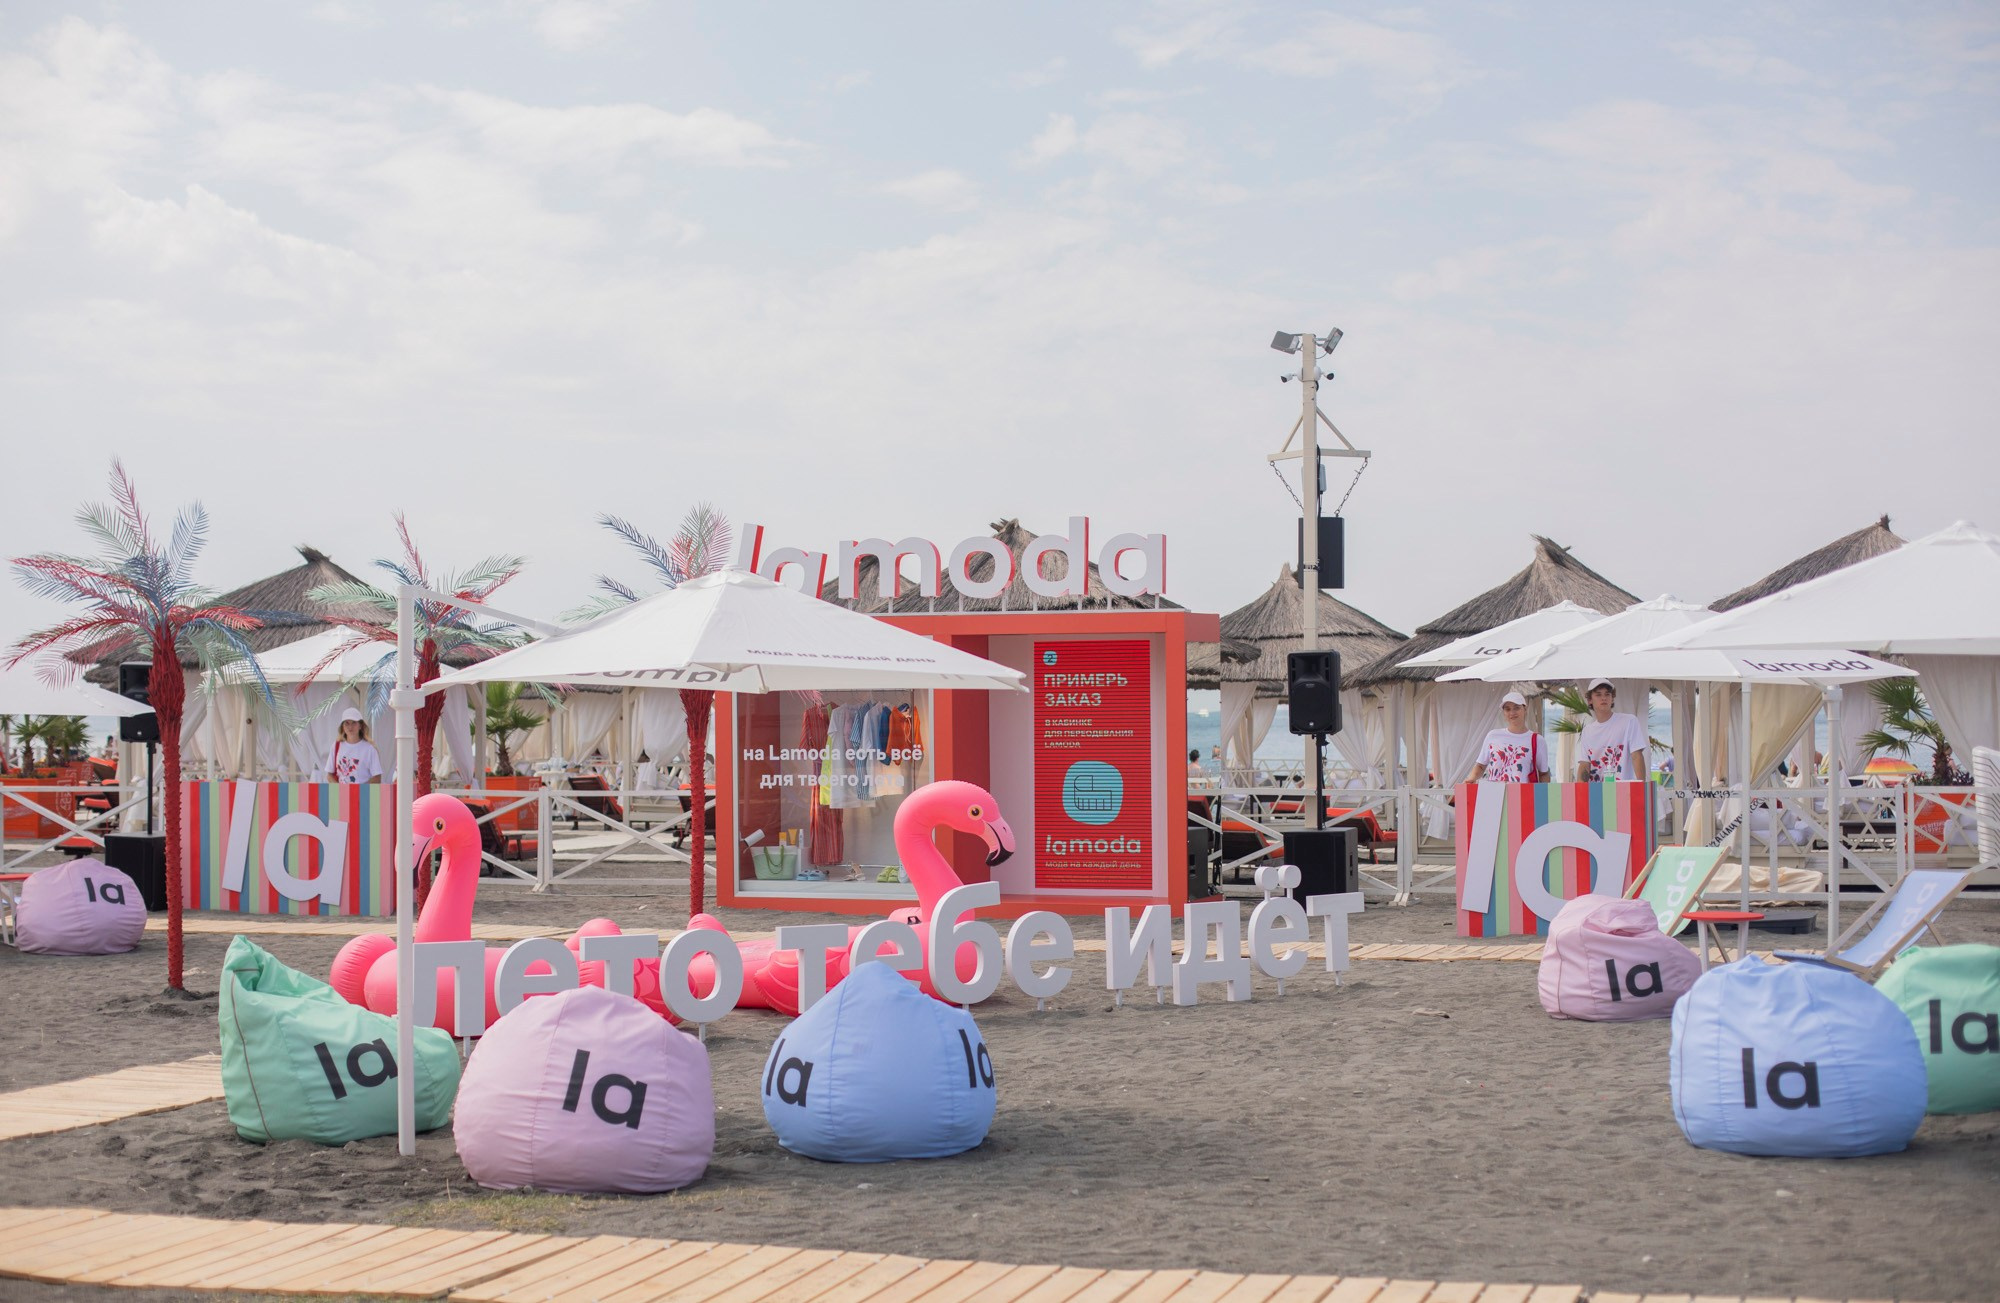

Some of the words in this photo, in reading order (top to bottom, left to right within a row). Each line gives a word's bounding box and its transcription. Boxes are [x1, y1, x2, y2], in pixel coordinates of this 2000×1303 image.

[738, 516, 1166, 599] lamoda
[1043, 673, 1128, 687] ПРИМЕРЬ
[1742, 659, 1873, 672] lamoda
[1044, 693, 1102, 707] ЗАКАЗ
[743, 748, 764, 761] на
[769, 745, 841, 761] Lamoda
[845, 748, 886, 761] есть
[891, 744, 922, 761] всё
[1044, 730, 1062, 738] ДЛЯ
[759, 774, 794, 789] для
[797, 774, 859, 787] твоего
[222, 778, 348, 905] la
[1045, 835, 1141, 855] lamoda
[1083, 860, 1118, 869] каждый
[1461, 780, 1631, 922] la
[84, 877, 126, 905] la
[776, 881, 1074, 1013] тебе
[1105, 864, 1364, 1006] идёт
[1605, 959, 1663, 1001] la
[1929, 999, 2000, 1055] la
[312, 1039, 398, 1100] la
[764, 1038, 814, 1108] la
[958, 1029, 994, 1090] la
[1741, 1047, 1821, 1110] la
[562, 1049, 648, 1129] la
